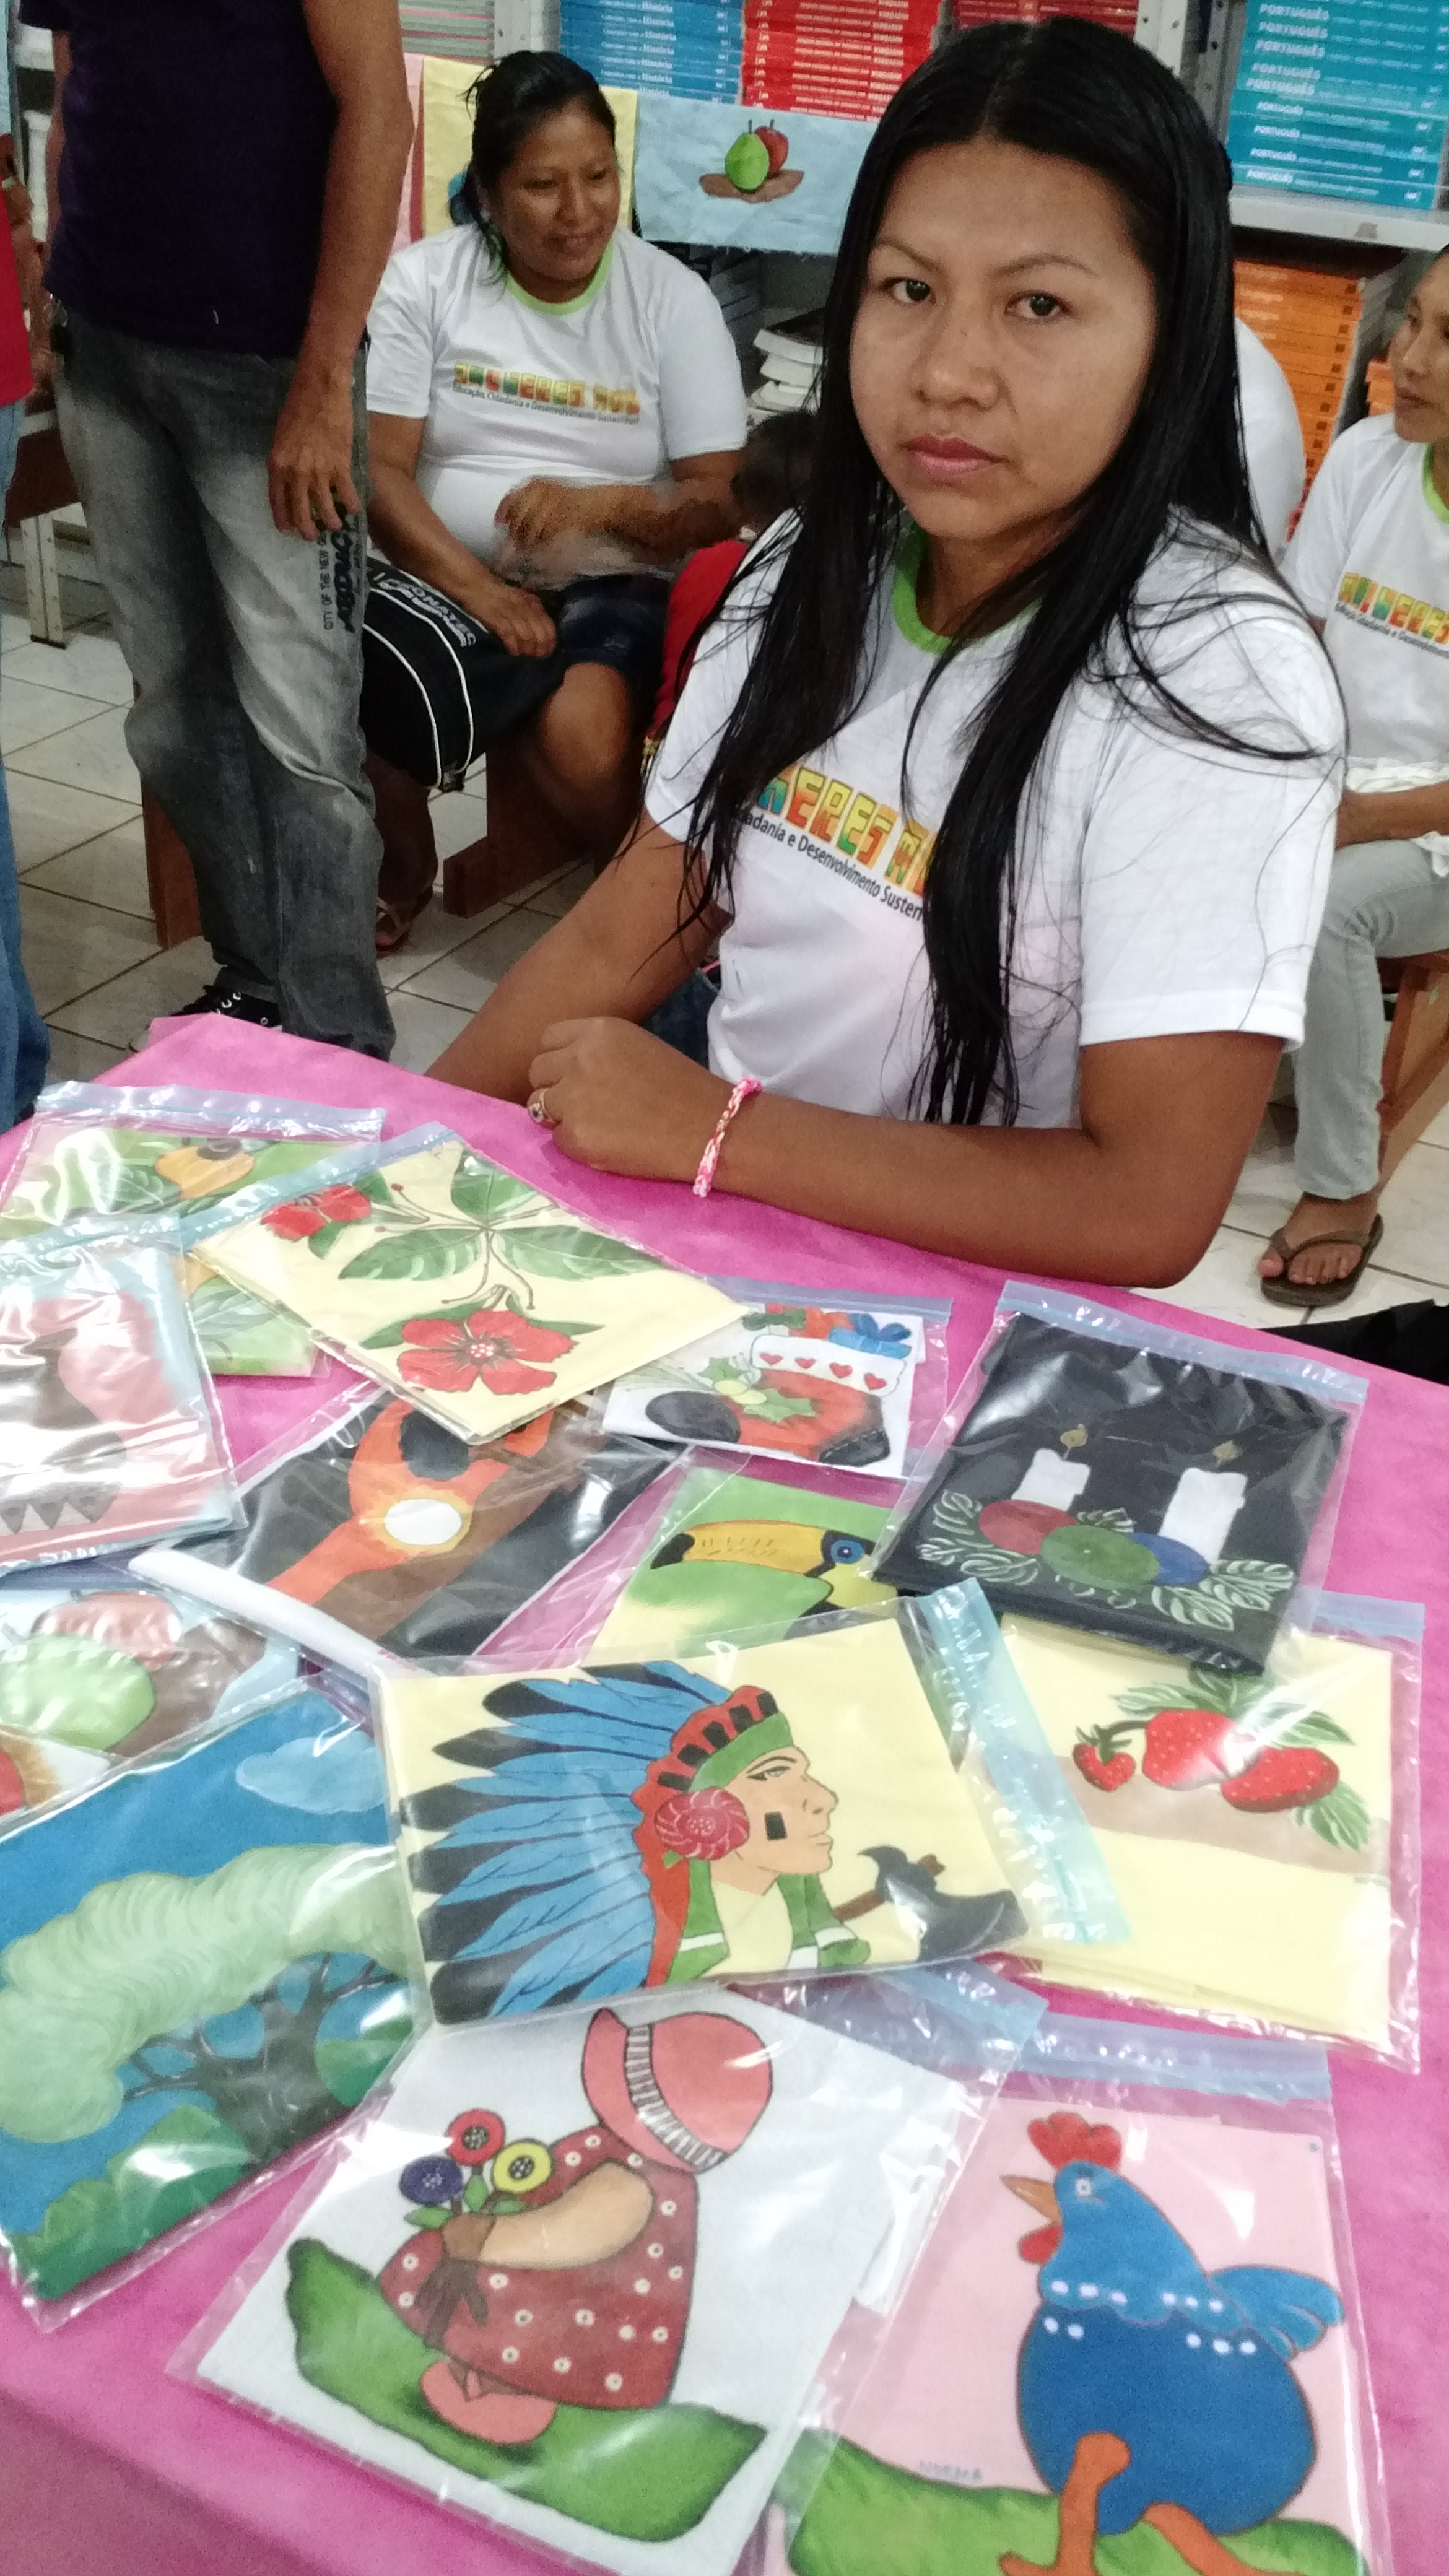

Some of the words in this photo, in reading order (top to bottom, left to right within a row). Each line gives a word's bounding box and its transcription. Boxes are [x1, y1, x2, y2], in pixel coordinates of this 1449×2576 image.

[744, 812, 786, 842] adania
[787, 833, 796, 848] e
[797, 834, 881, 897] Desenvolvimento
[879, 886, 923, 921] Susten
